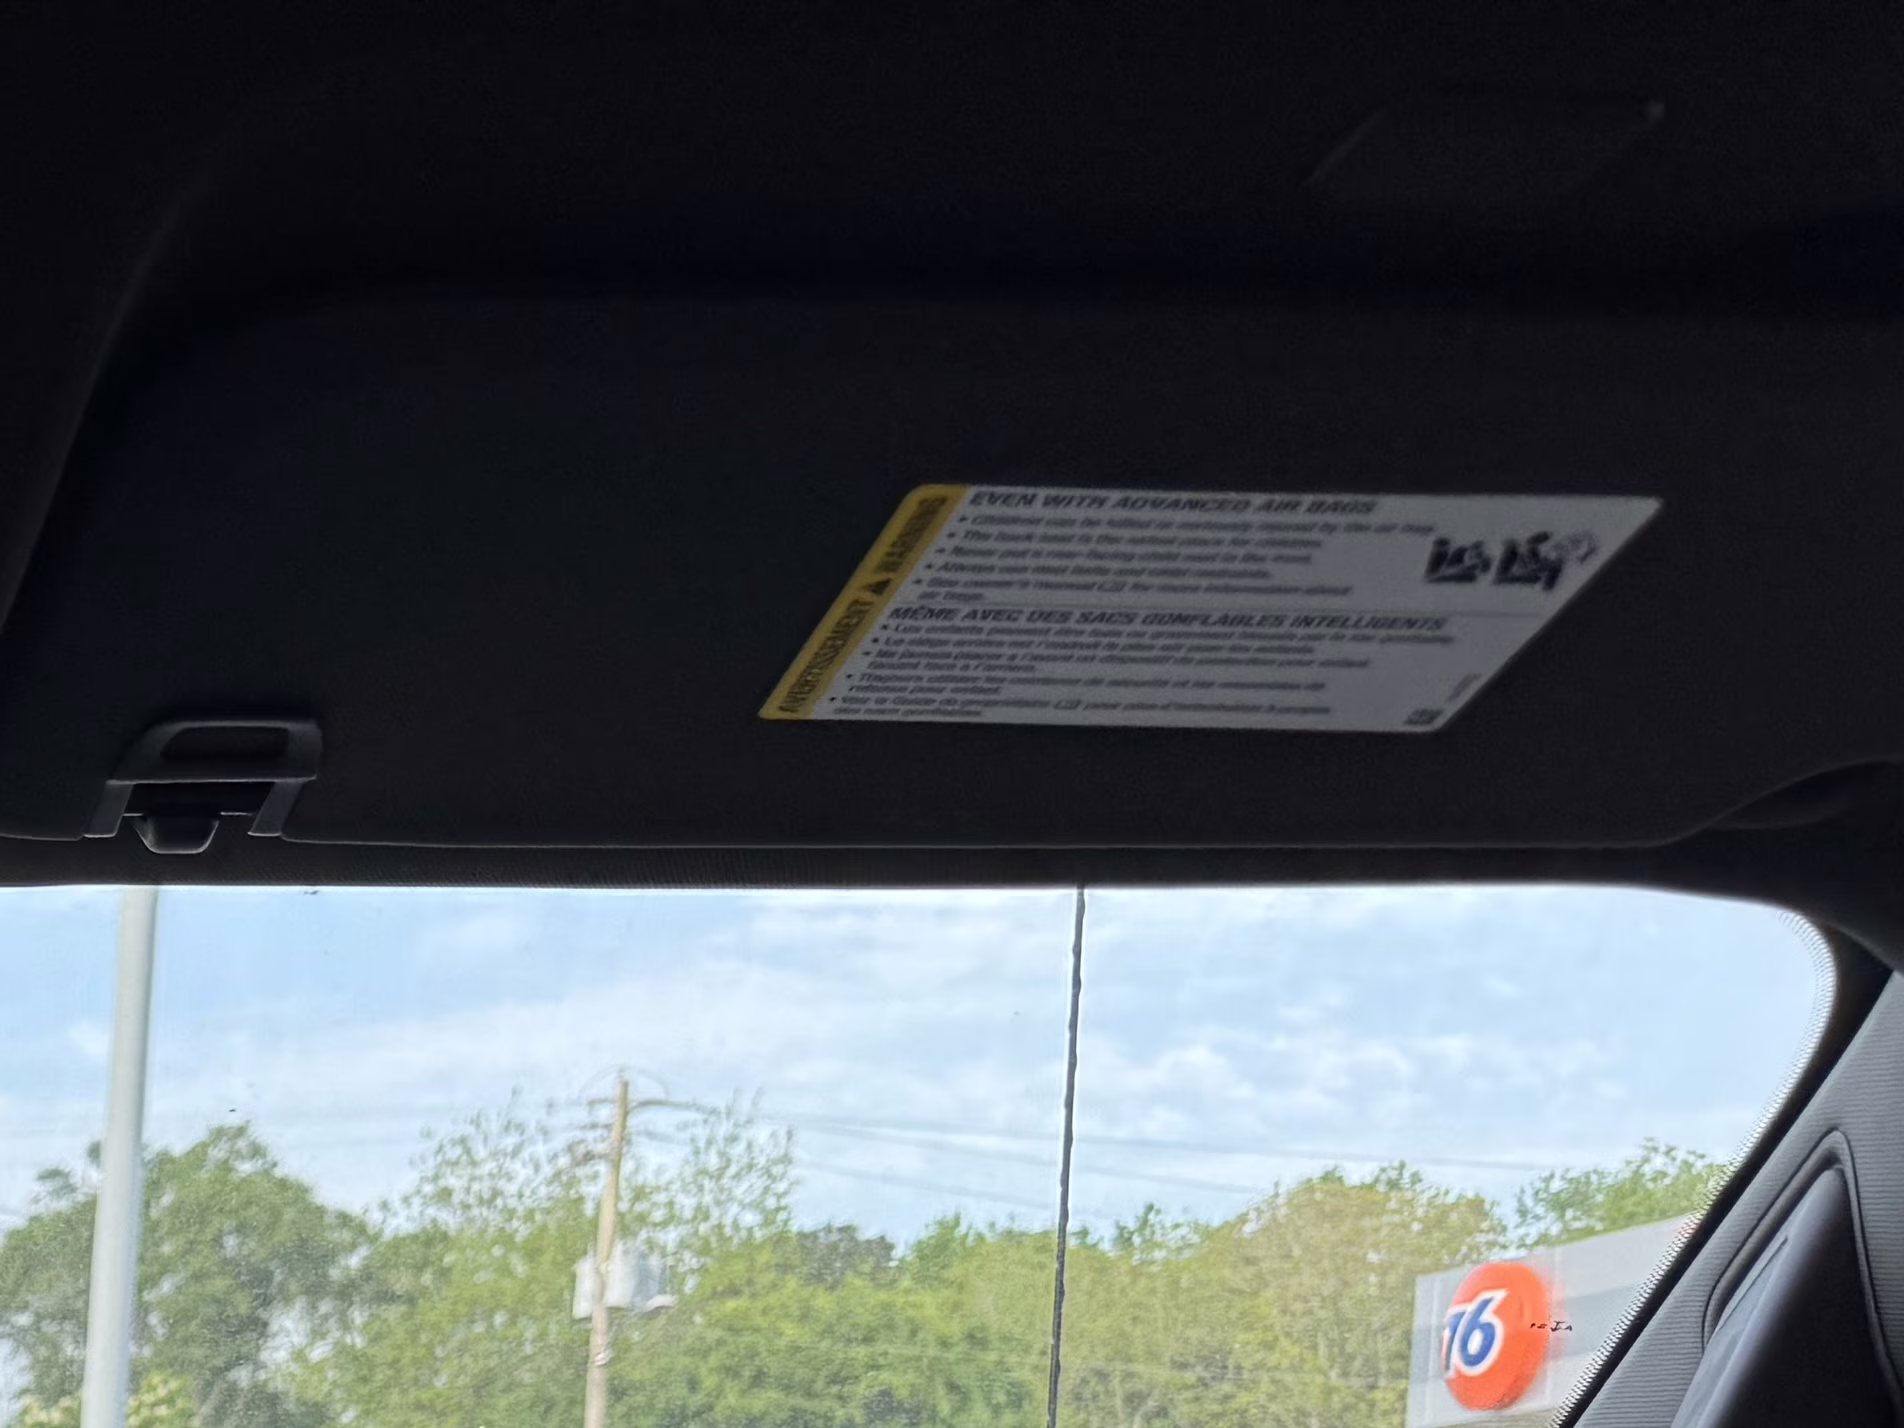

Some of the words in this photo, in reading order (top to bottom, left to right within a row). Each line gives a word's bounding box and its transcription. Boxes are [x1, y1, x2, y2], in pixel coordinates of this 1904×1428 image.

[970, 491, 1037, 507] EVEN
[1041, 493, 1106, 508] WITH
[1112, 494, 1251, 512] ADVANCED
[1257, 498, 1303, 513] AIR
[1306, 499, 1379, 514] BAGS
[1441, 1289, 1508, 1378] 76
